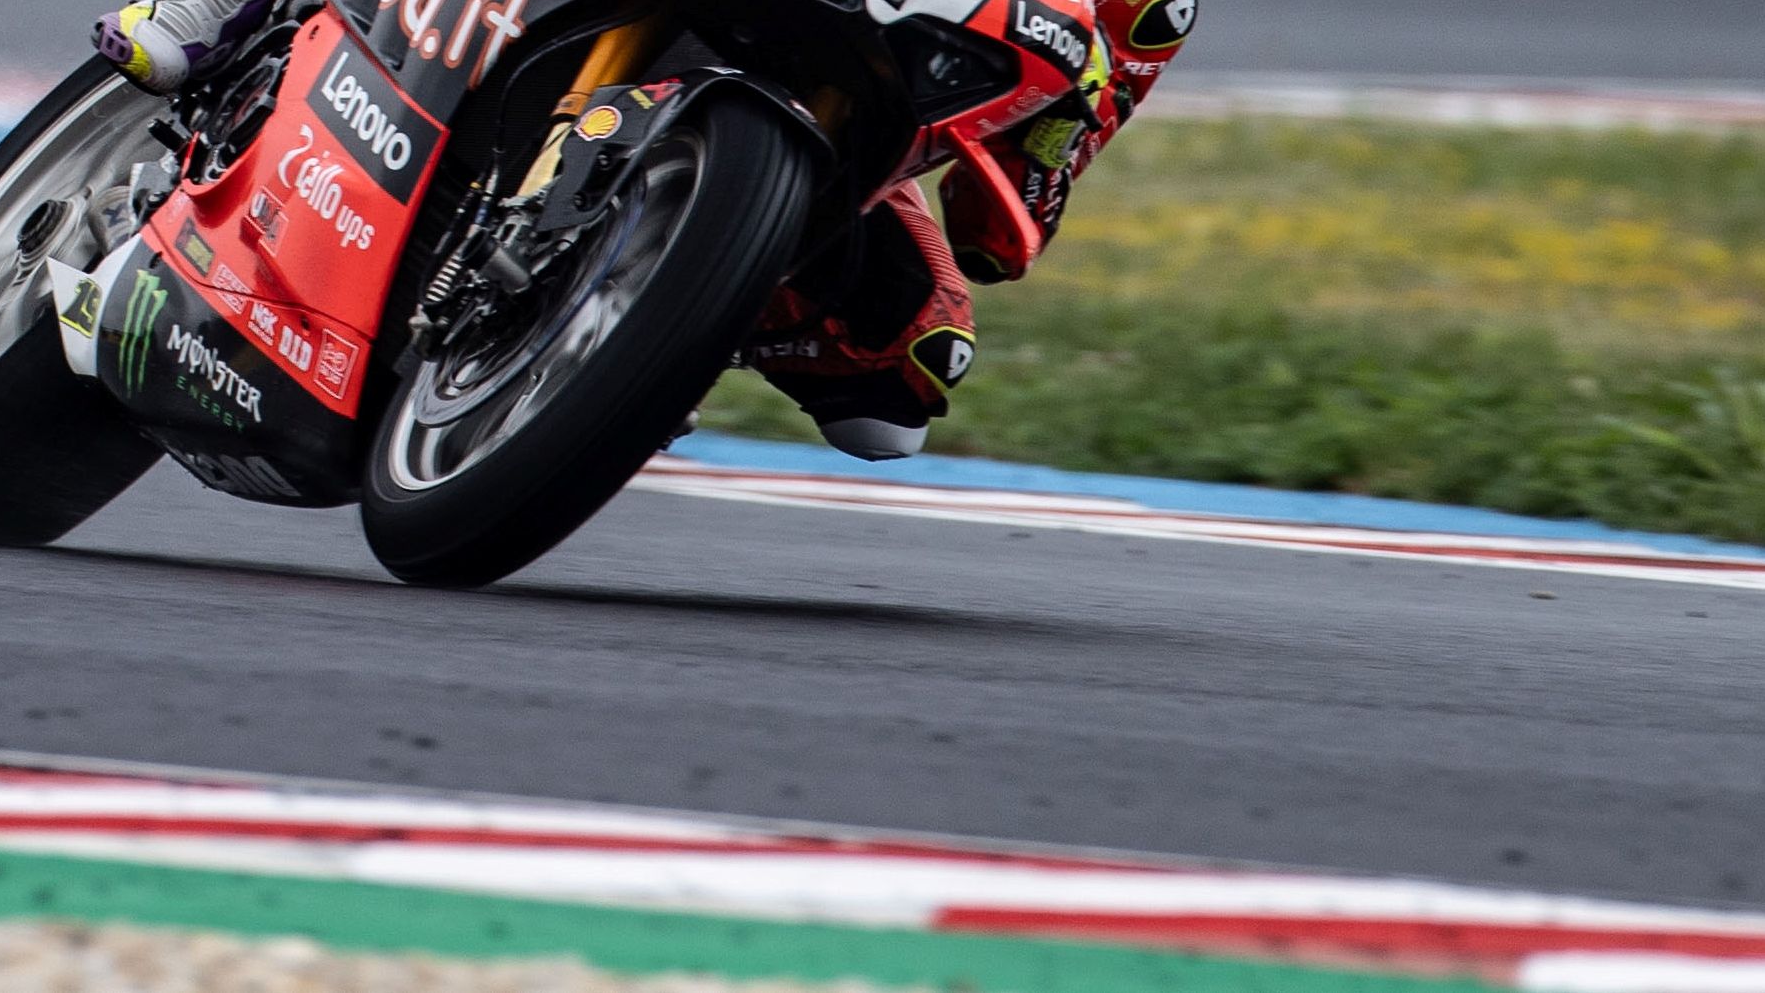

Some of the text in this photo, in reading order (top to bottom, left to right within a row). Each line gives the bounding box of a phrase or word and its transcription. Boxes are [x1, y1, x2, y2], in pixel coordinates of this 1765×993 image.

[1015, 0, 1086, 69] Lenovo
[321, 51, 412, 171] Lenovo
[335, 207, 376, 251] ups
[166, 323, 262, 424] MONSTER
